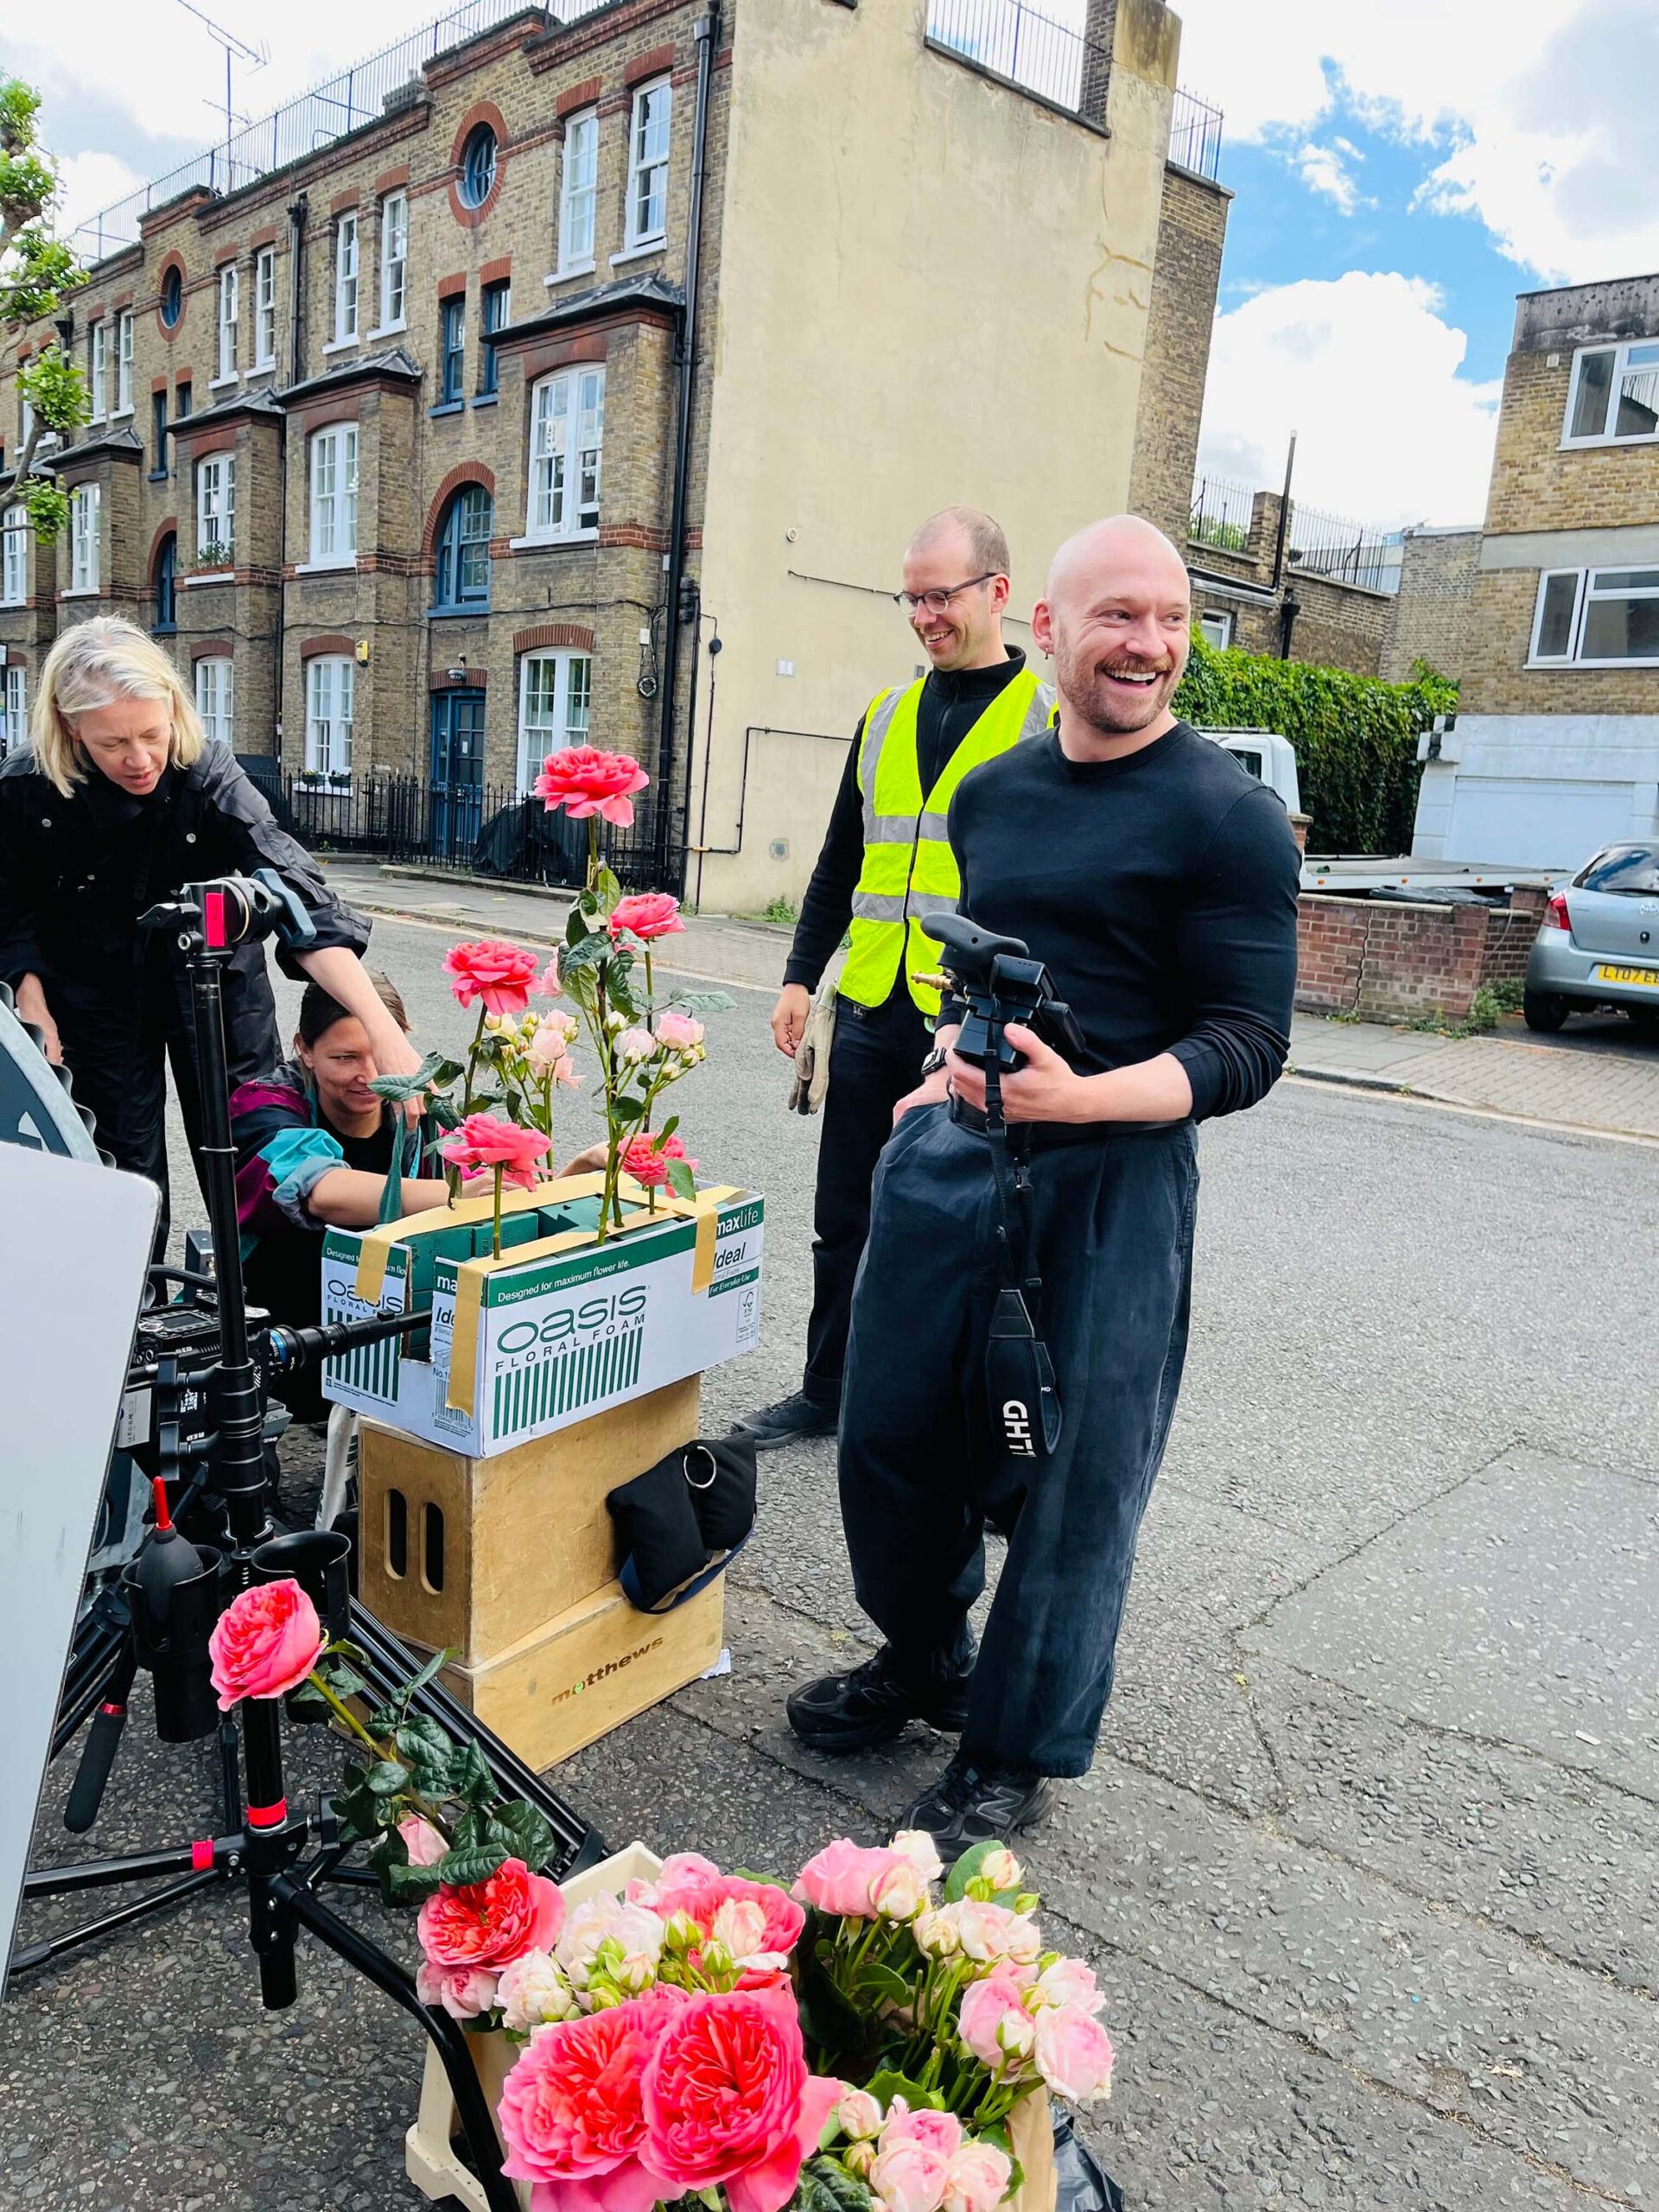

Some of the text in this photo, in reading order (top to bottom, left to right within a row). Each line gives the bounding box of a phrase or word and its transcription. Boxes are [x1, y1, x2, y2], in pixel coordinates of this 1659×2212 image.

[326, 1248, 355, 1262] Designed
[713, 1242, 747, 1269] Ideal
[498, 1284, 539, 1303] Designed
[541, 1281, 552, 1291] for
[554, 1271, 592, 1288] maximum
[593, 1264, 616, 1278] flower
[327, 1295, 367, 1313] FLORAL
[495, 1313, 645, 1372] FLORAL FOAM
